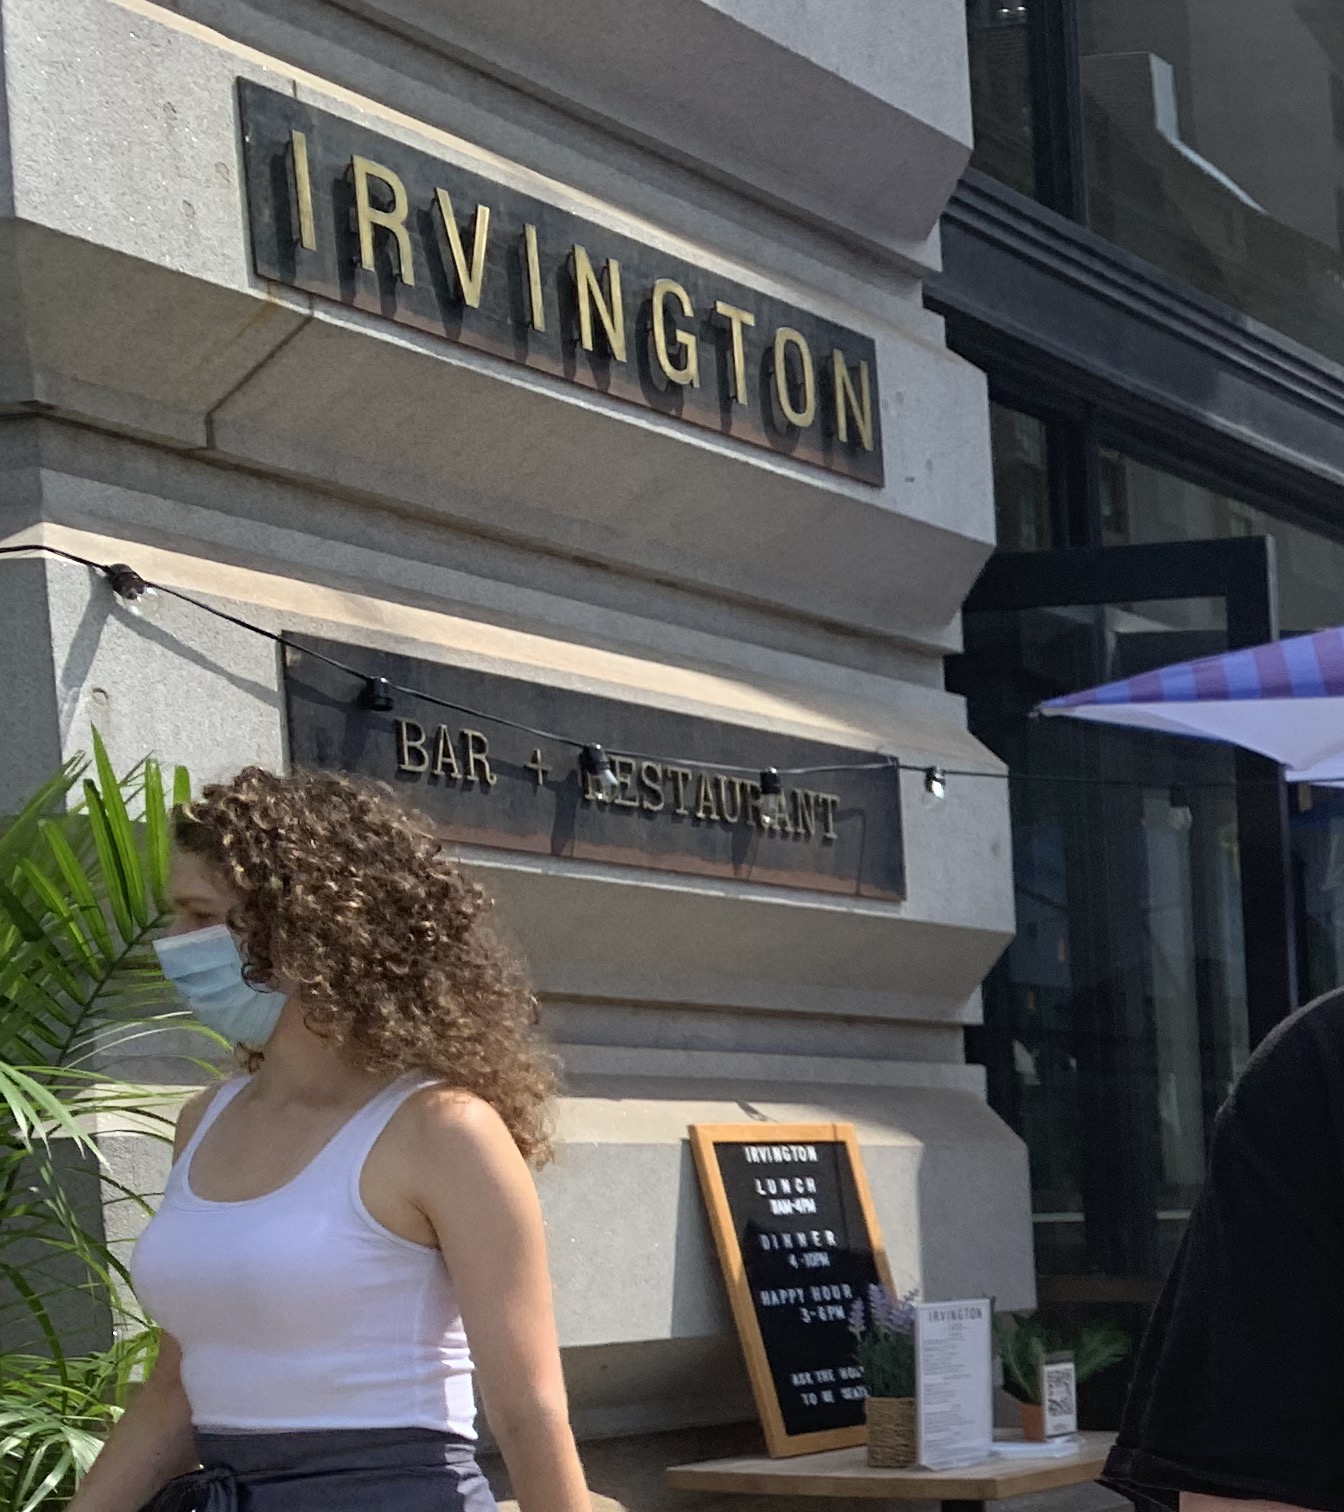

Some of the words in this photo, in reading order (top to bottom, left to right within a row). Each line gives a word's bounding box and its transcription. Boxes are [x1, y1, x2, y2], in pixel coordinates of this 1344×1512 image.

[290, 130, 873, 452] IRVINGTON
[397, 718, 497, 786] BAR
[744, 1144, 818, 1163] IRVINGTON
[755, 1177, 817, 1195] LUNCH
[760, 1230, 837, 1250] DINNER
[760, 1288, 805, 1307] HAPPY
[809, 1283, 853, 1302] HOUR
